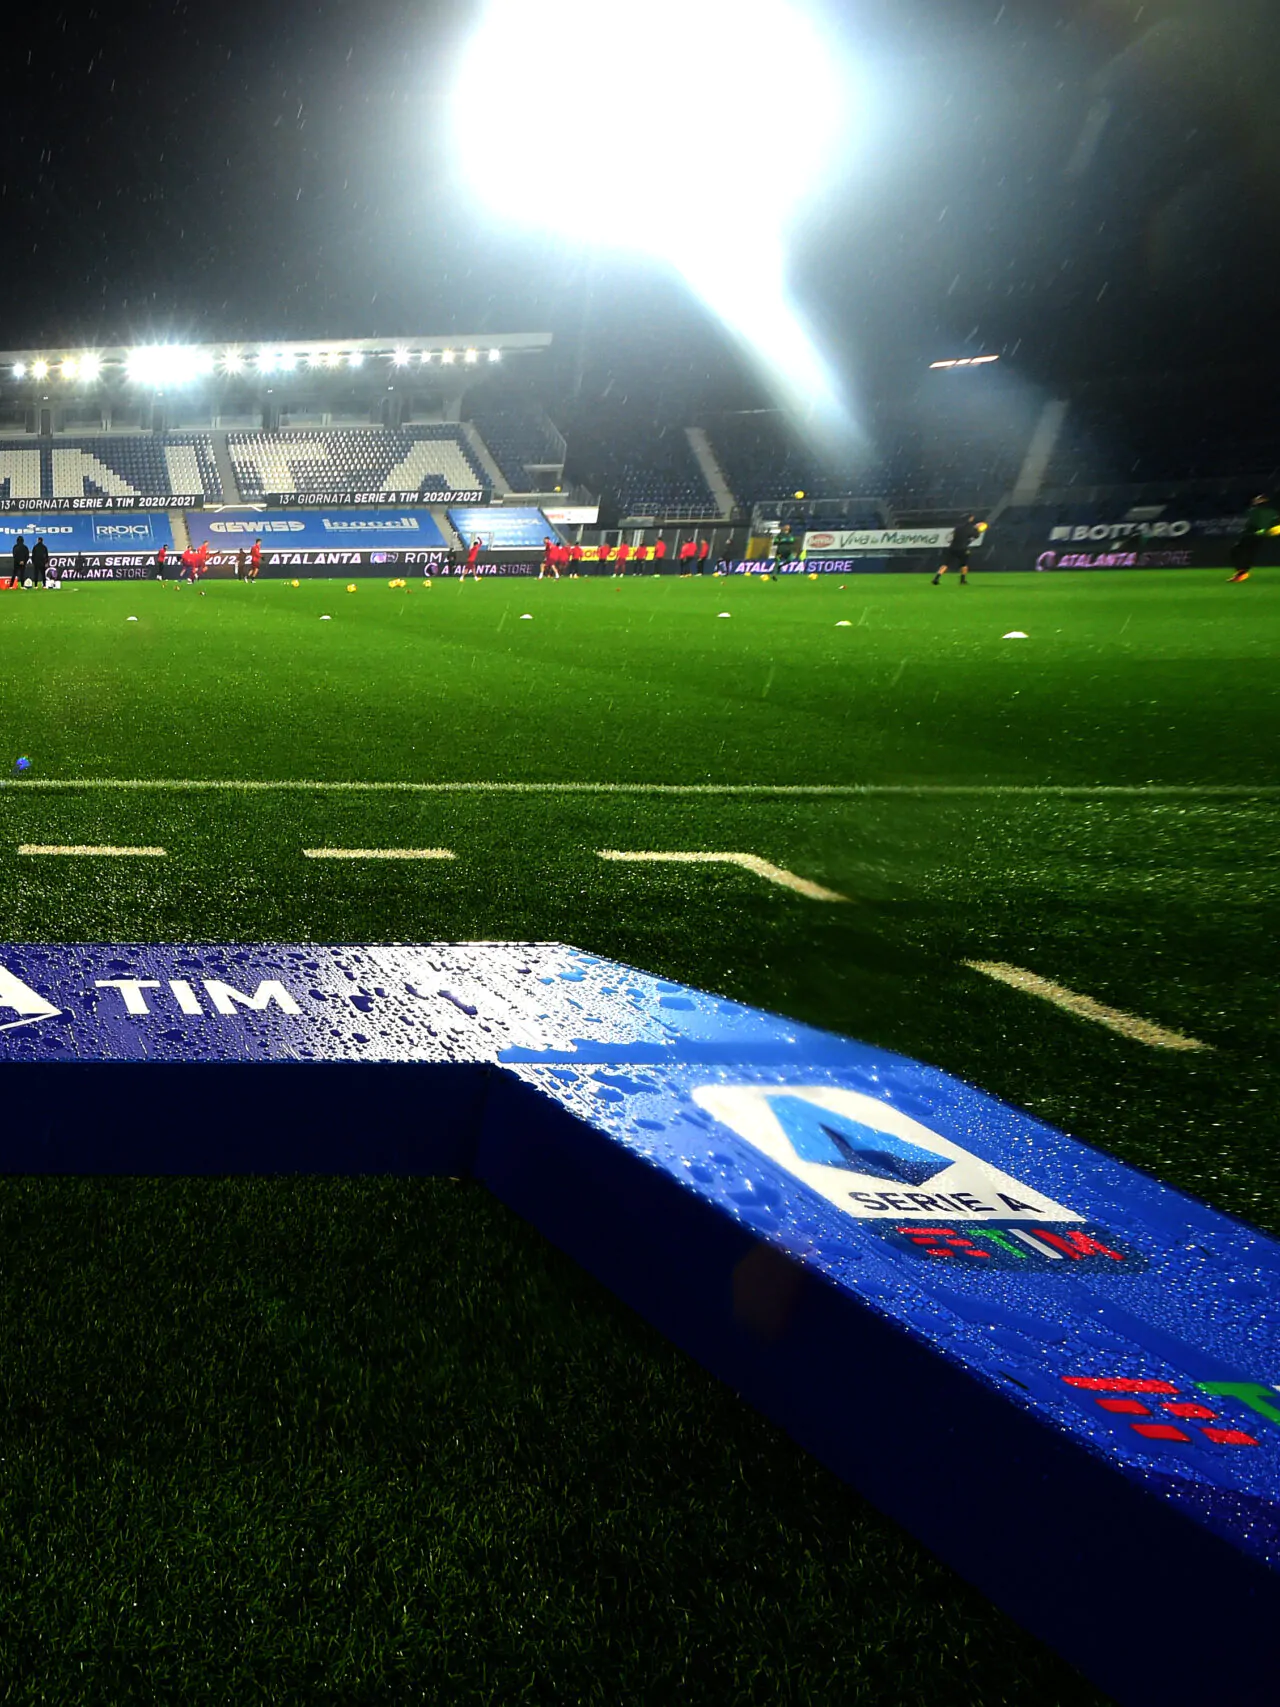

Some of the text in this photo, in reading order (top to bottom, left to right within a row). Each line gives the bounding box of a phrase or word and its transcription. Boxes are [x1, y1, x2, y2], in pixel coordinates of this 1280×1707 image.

[18, 499, 70, 510] GIORNATA
[72, 498, 103, 509] SERIE
[105, 498, 113, 508] A
[116, 497, 134, 507] TIM
[138, 496, 196, 507] 2020/2021
[298, 493, 351, 504] GIORNATA
[354, 492, 386, 503] SERIE
[387, 492, 397, 502] A
[400, 491, 419, 502] TIM
[423, 491, 483, 502] 2020/2021
[96, 524, 149, 535] RADICI
[209, 521, 306, 533] GEWISS
[880, 532, 940, 545] Mamma
[105, 556, 142, 567] SERIE
[145, 556, 156, 566] A
[269, 552, 362, 565] ATALANTA
[1056, 552, 1137, 568] ATALANTA
[116, 567, 148, 579] STORE
[499, 563, 534, 575] STORE
[807, 560, 854, 573] STORE
[96, 978, 302, 1016] TIM
[847, 1190, 1043, 1215] SERIE A
[966, 1227, 1128, 1262] TIM
